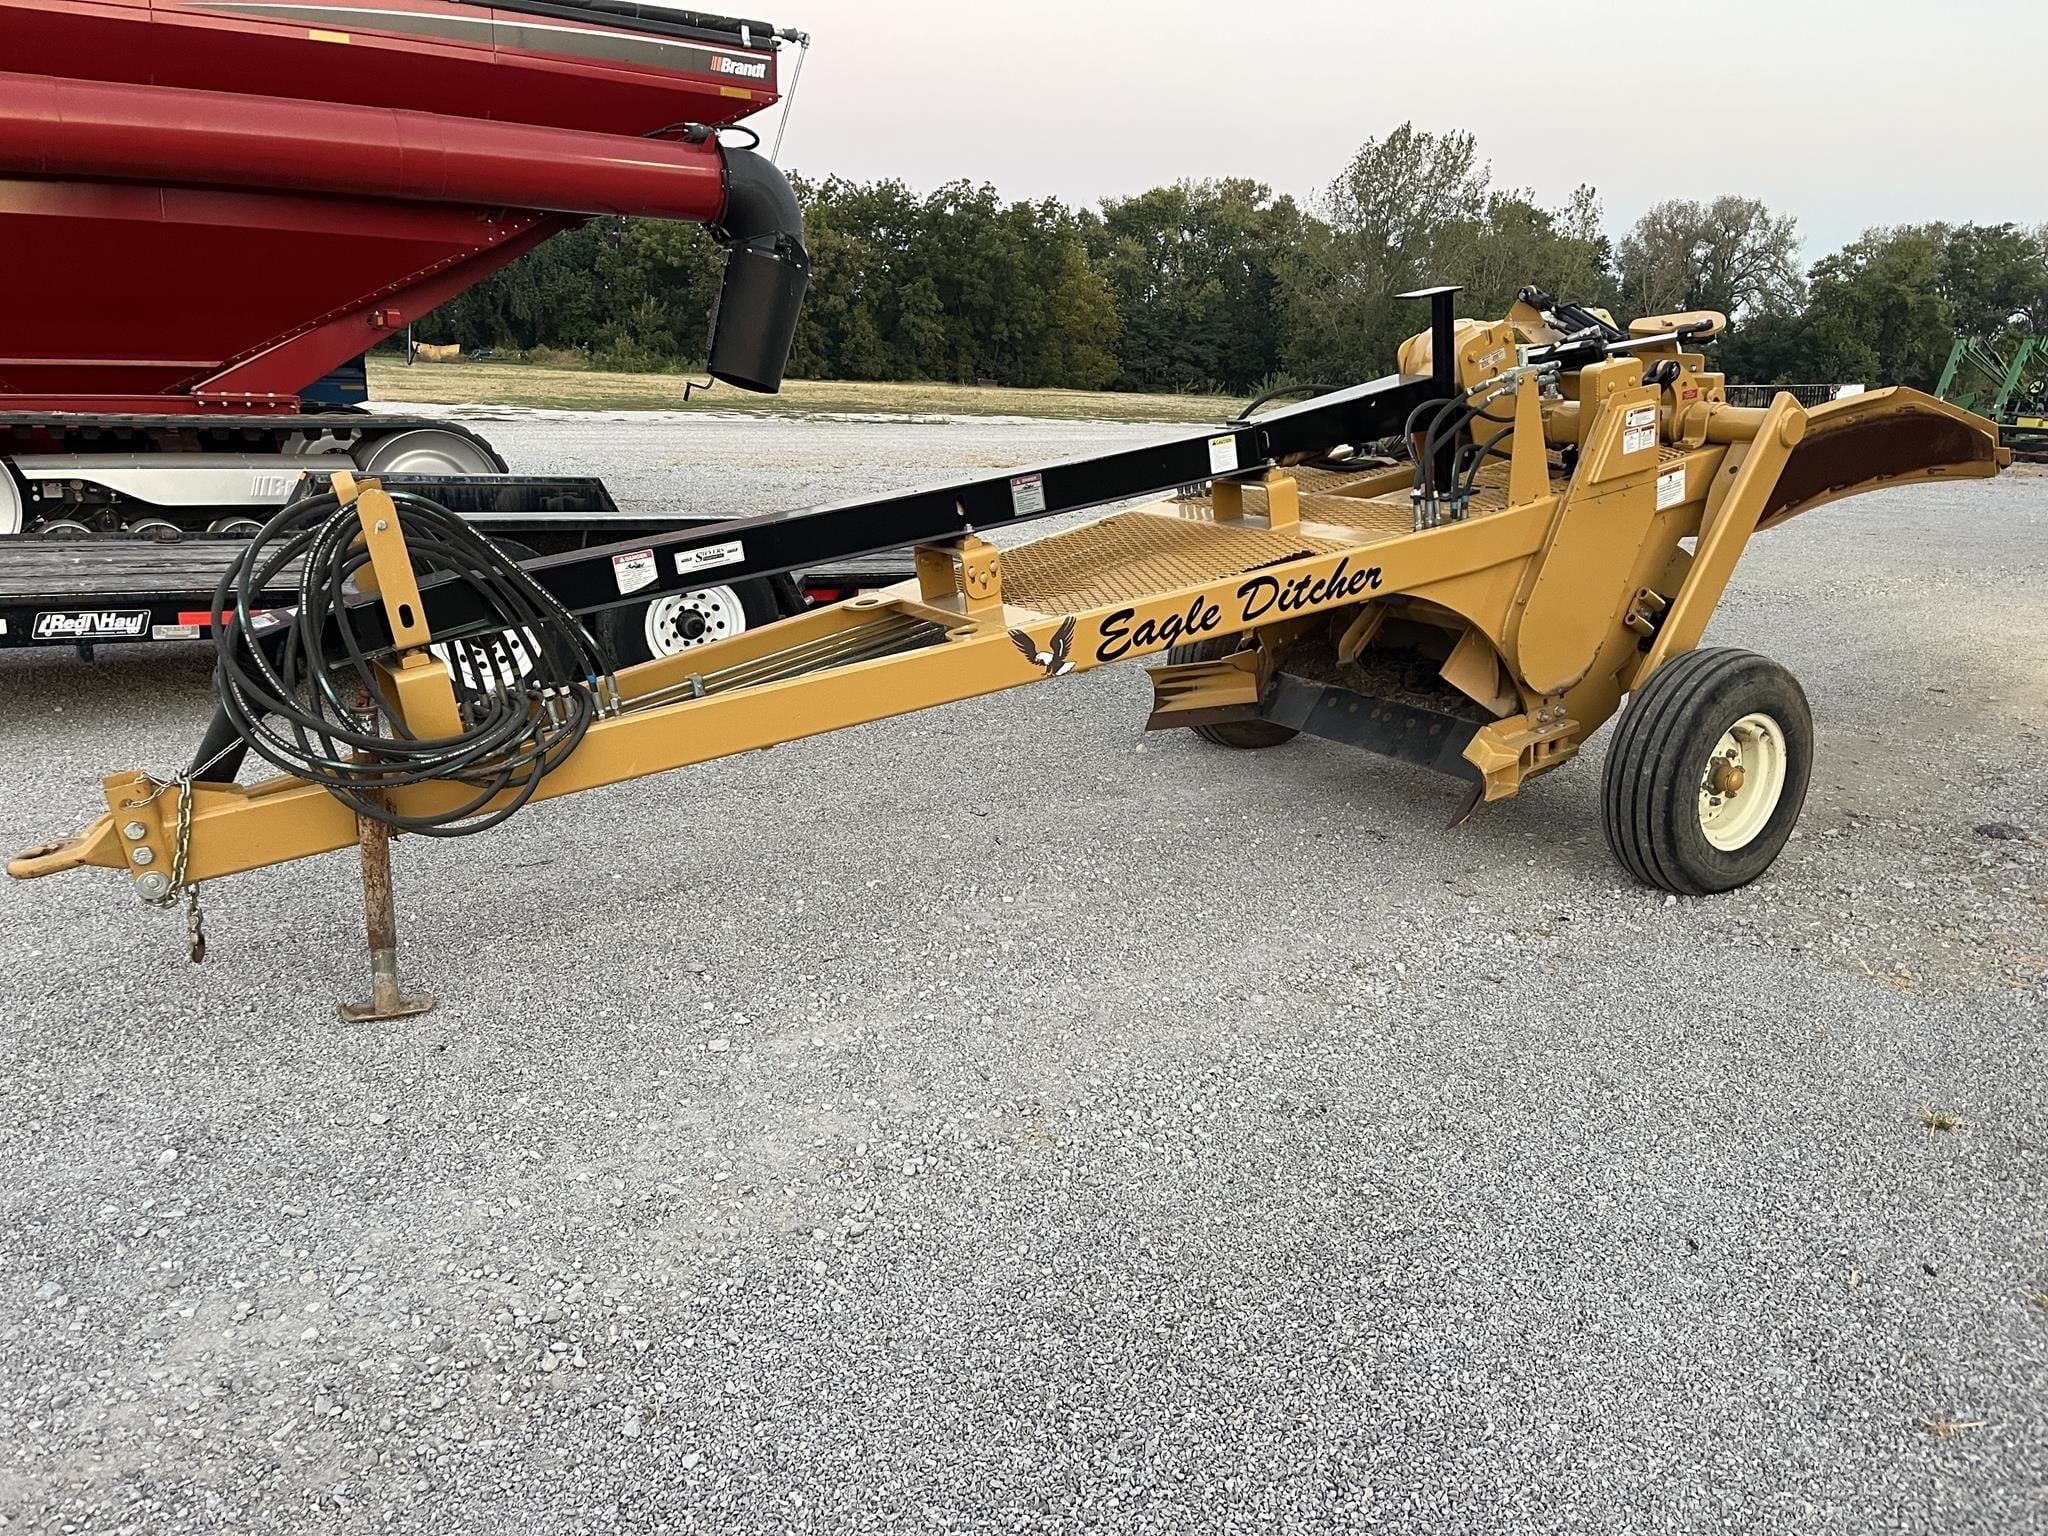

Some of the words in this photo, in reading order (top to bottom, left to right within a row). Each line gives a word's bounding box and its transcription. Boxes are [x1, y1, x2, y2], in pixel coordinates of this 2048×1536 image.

[721, 57, 766, 78] Brandt
[1096, 595, 1221, 662] Eagle
[1237, 557, 1382, 622] Ditcher
[101, 612, 143, 630] Haul
